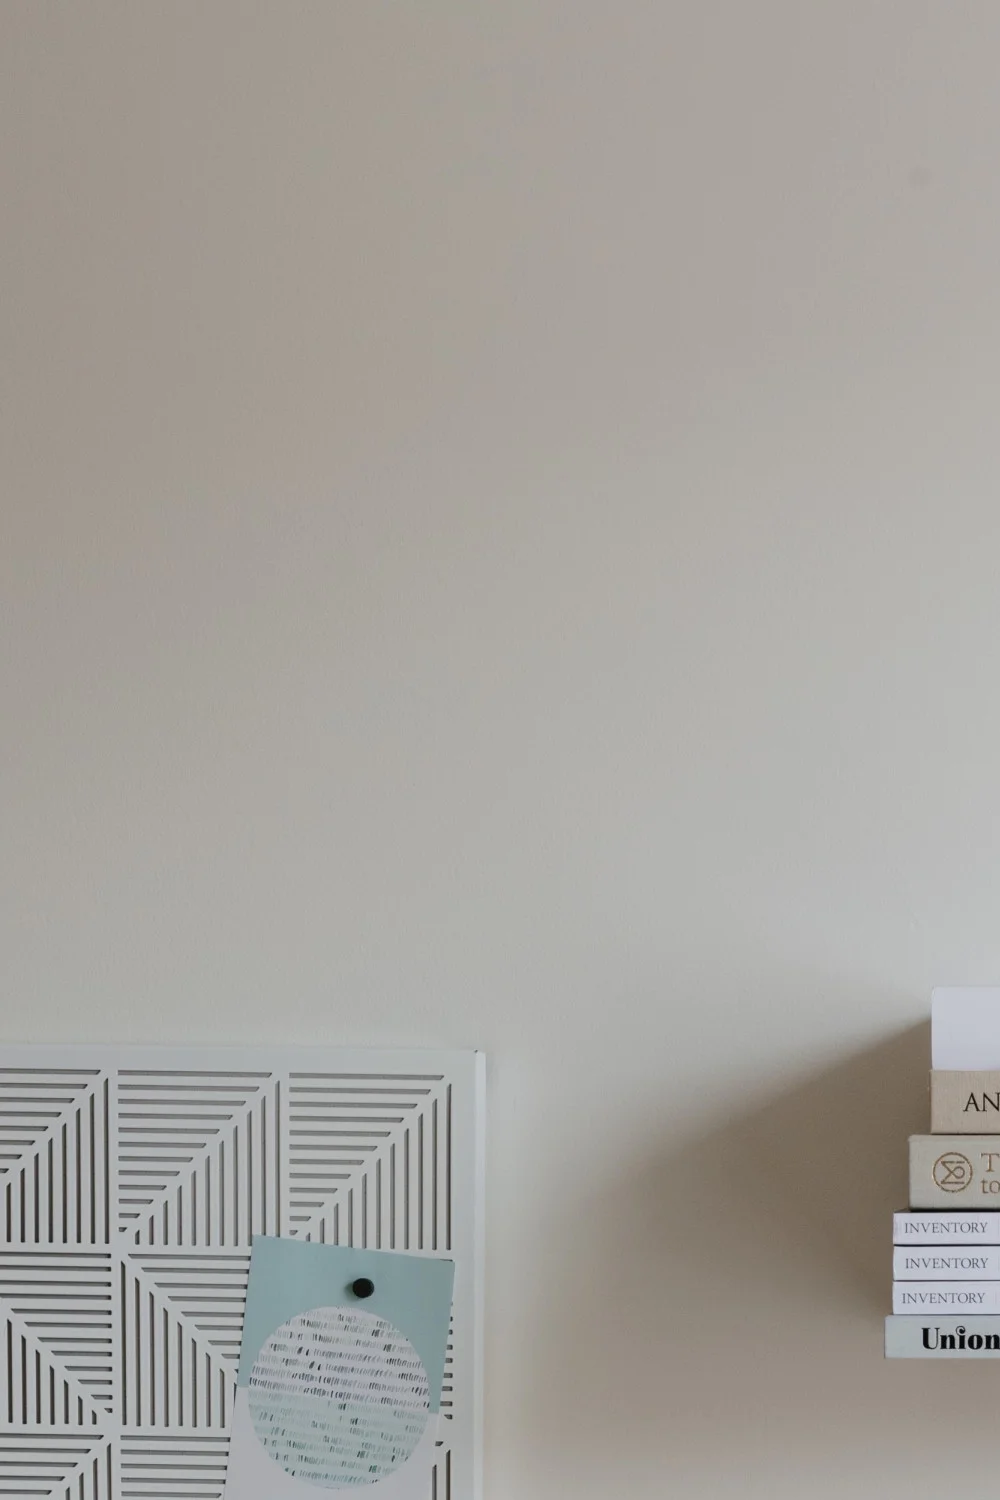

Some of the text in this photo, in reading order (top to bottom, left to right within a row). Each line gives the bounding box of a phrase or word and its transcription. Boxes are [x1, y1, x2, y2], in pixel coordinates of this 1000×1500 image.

[980, 1177, 1000, 1194] to
[904, 1222, 988, 1234] INVENTORY
[905, 1258, 989, 1269] INVENTORY
[902, 1293, 986, 1304] INVENTORY
